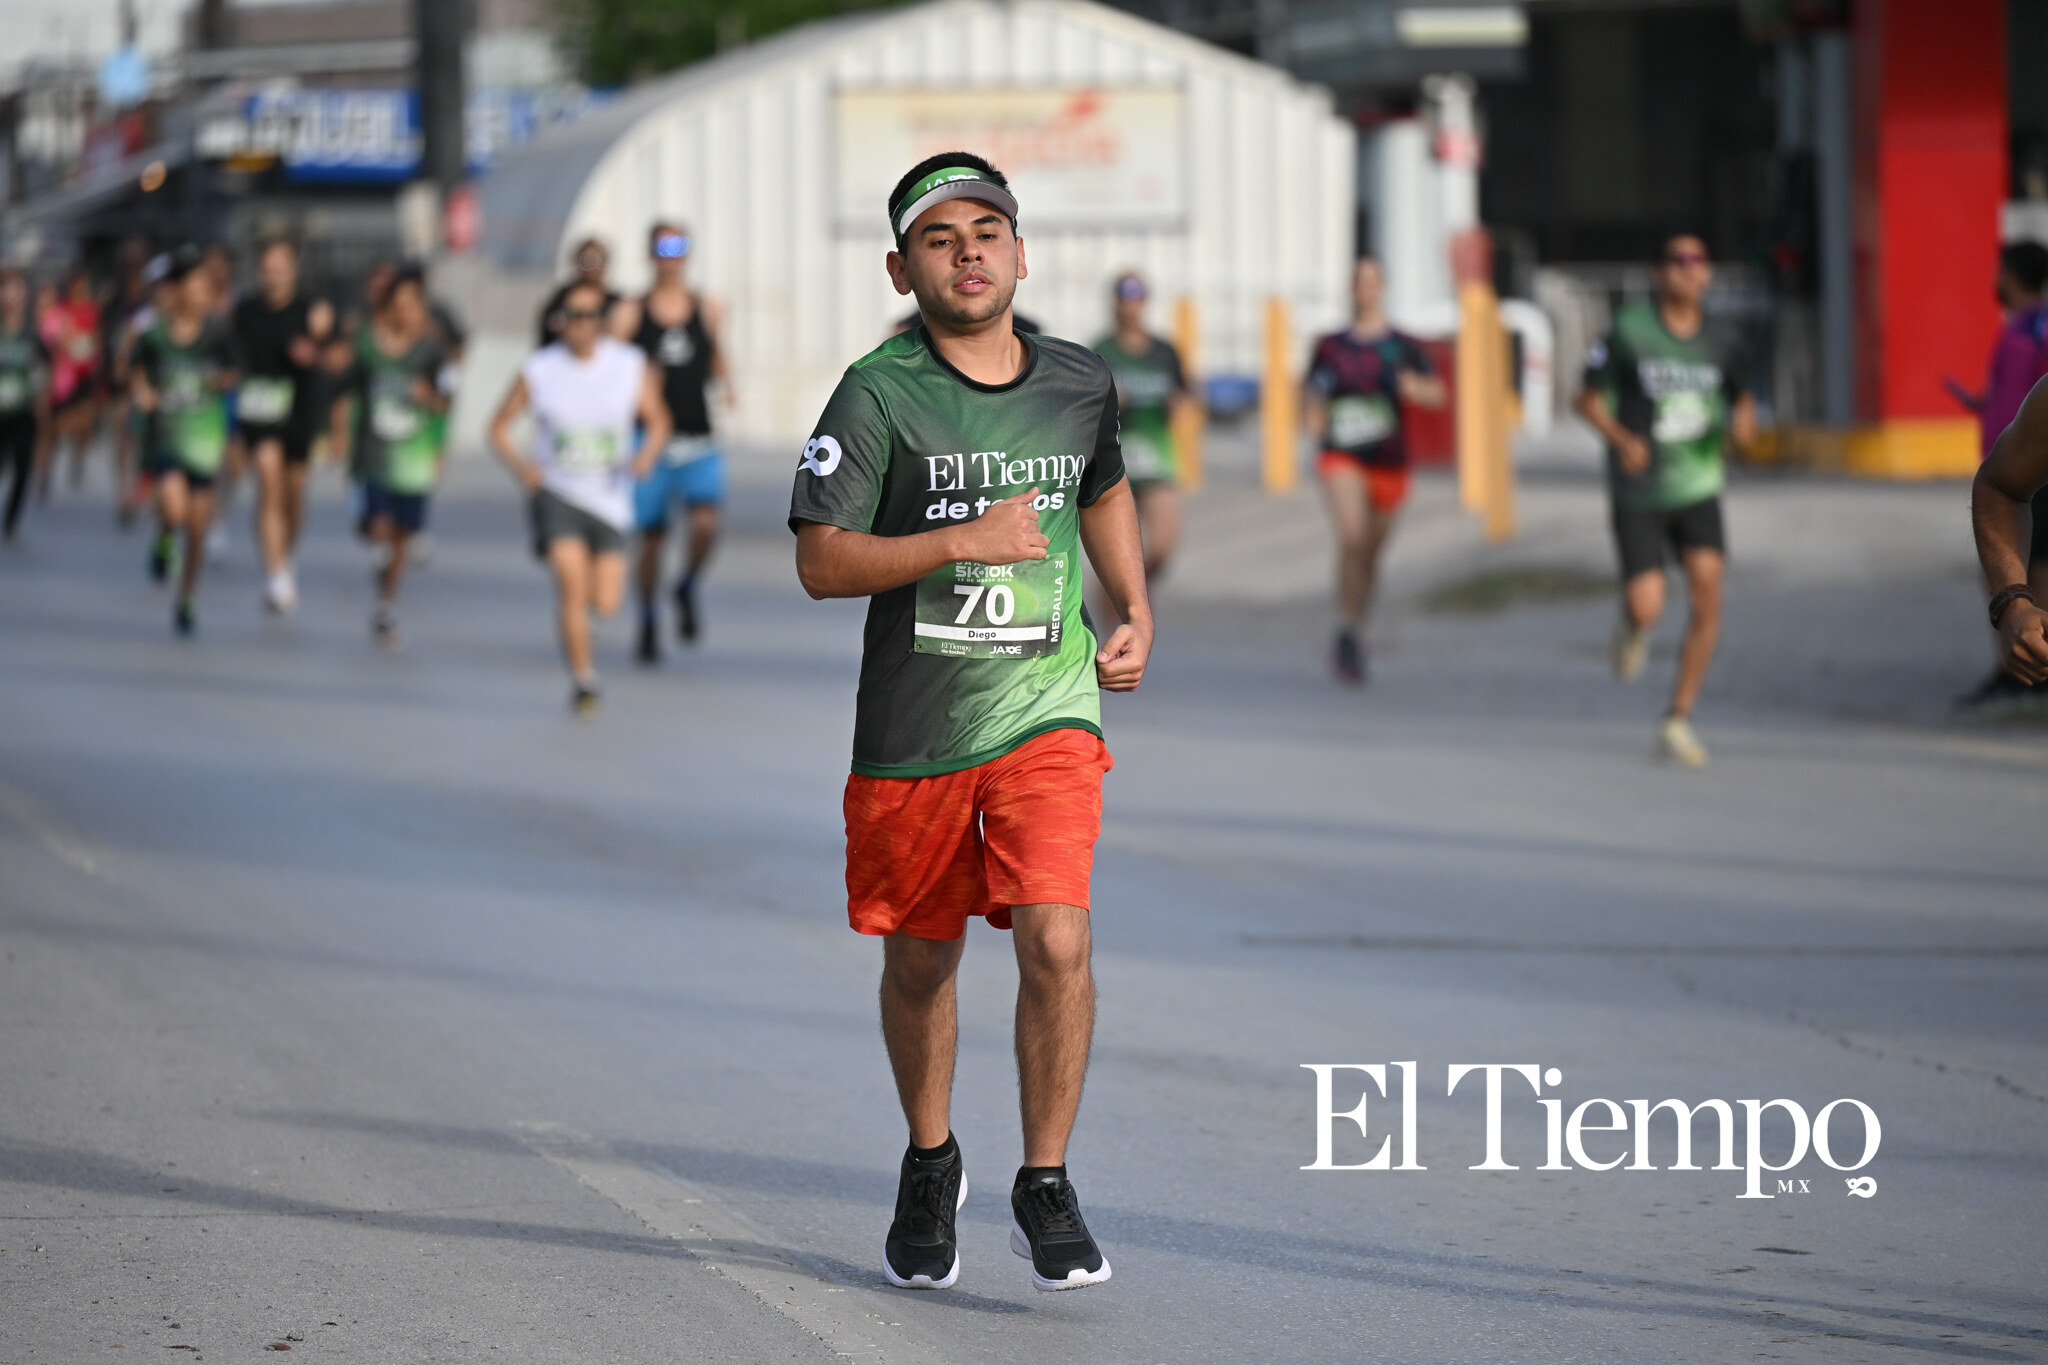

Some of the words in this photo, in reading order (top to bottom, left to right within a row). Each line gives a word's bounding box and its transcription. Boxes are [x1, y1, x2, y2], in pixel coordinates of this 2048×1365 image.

[924, 453, 967, 492] El
[971, 451, 1086, 489] Tiempo
[925, 498, 969, 520] de
[975, 492, 1065, 517] tos
[955, 565, 980, 578] 5K
[984, 565, 1014, 578] 10K
[1055, 560, 1064, 569] 70
[954, 584, 1015, 626] 70
[1050, 575, 1064, 643] MEDALLA
[968, 630, 997, 640] Diego
